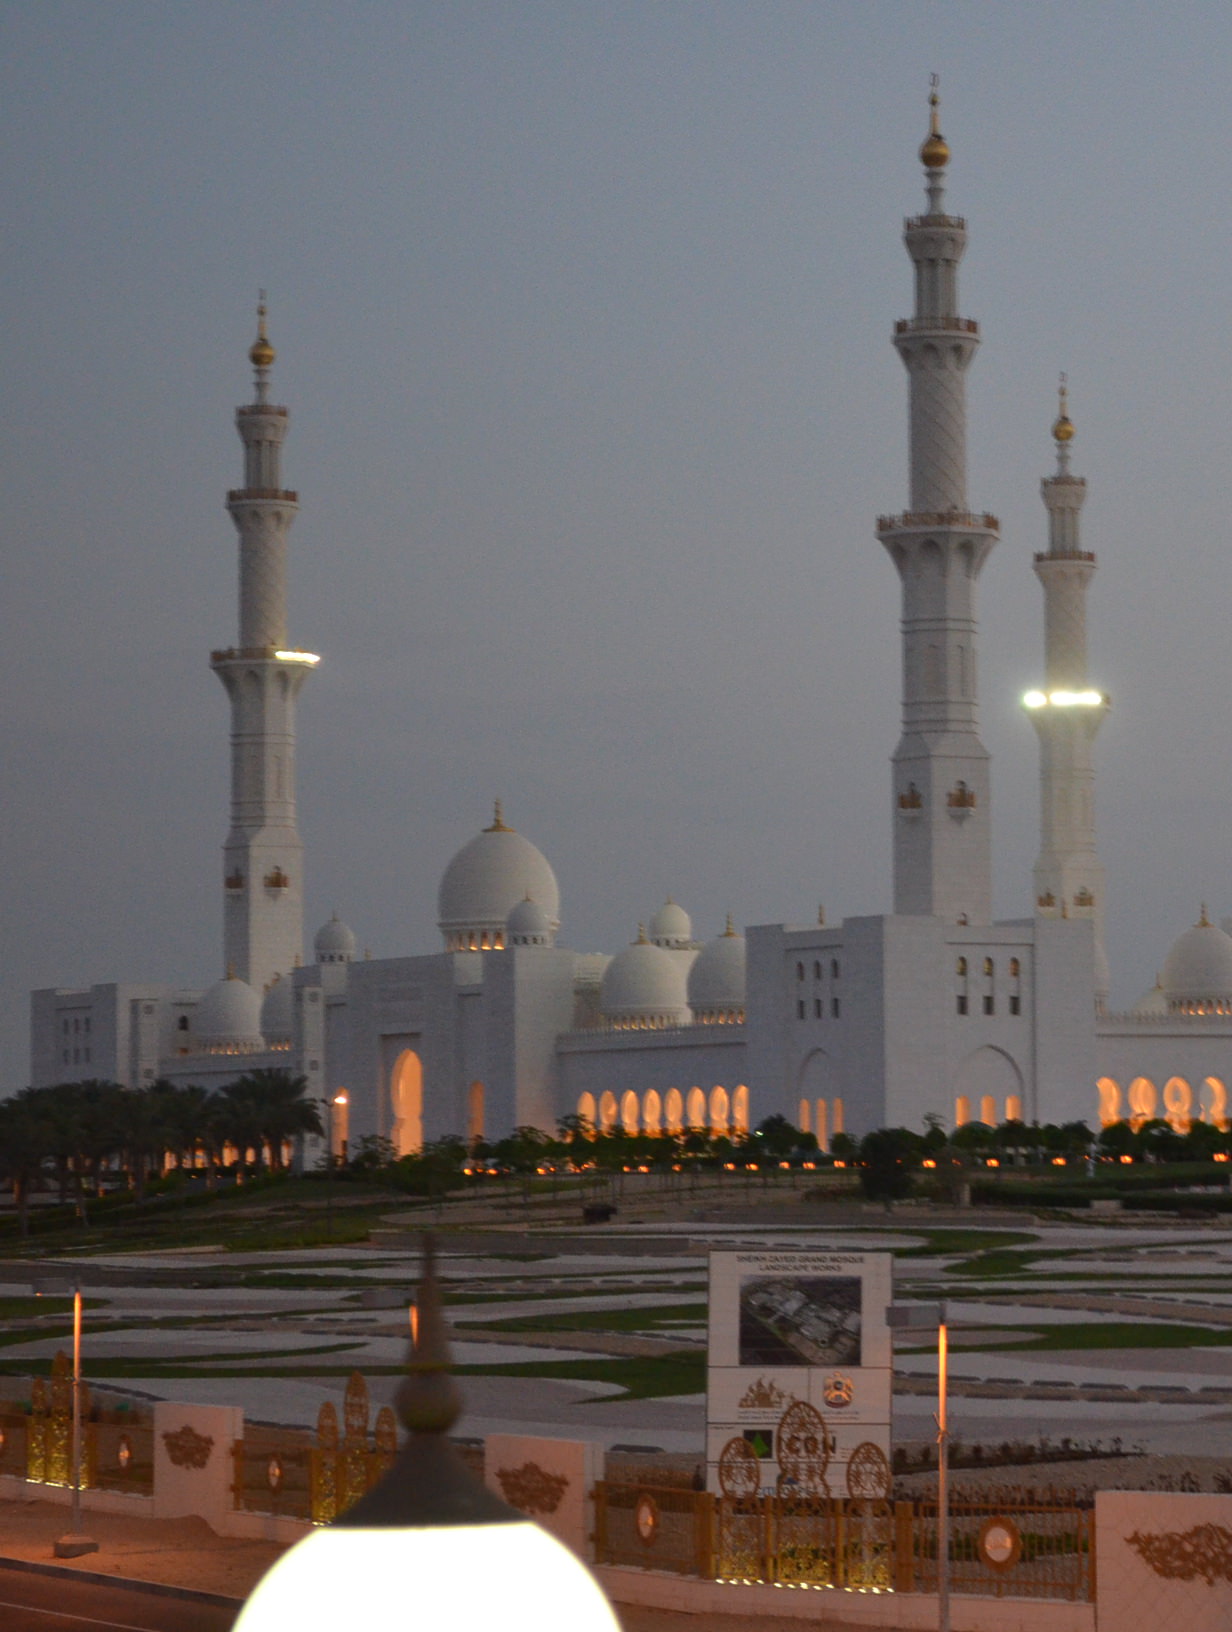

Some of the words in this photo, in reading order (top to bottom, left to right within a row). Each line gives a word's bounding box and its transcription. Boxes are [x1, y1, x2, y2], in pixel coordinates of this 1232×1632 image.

[768, 1255, 796, 1263] ZAYED
[798, 1255, 828, 1264] GRAND
[829, 1256, 865, 1264] MOSQUE
[759, 1263, 808, 1272] LANDSCAPE
[811, 1264, 842, 1272] WORKS
